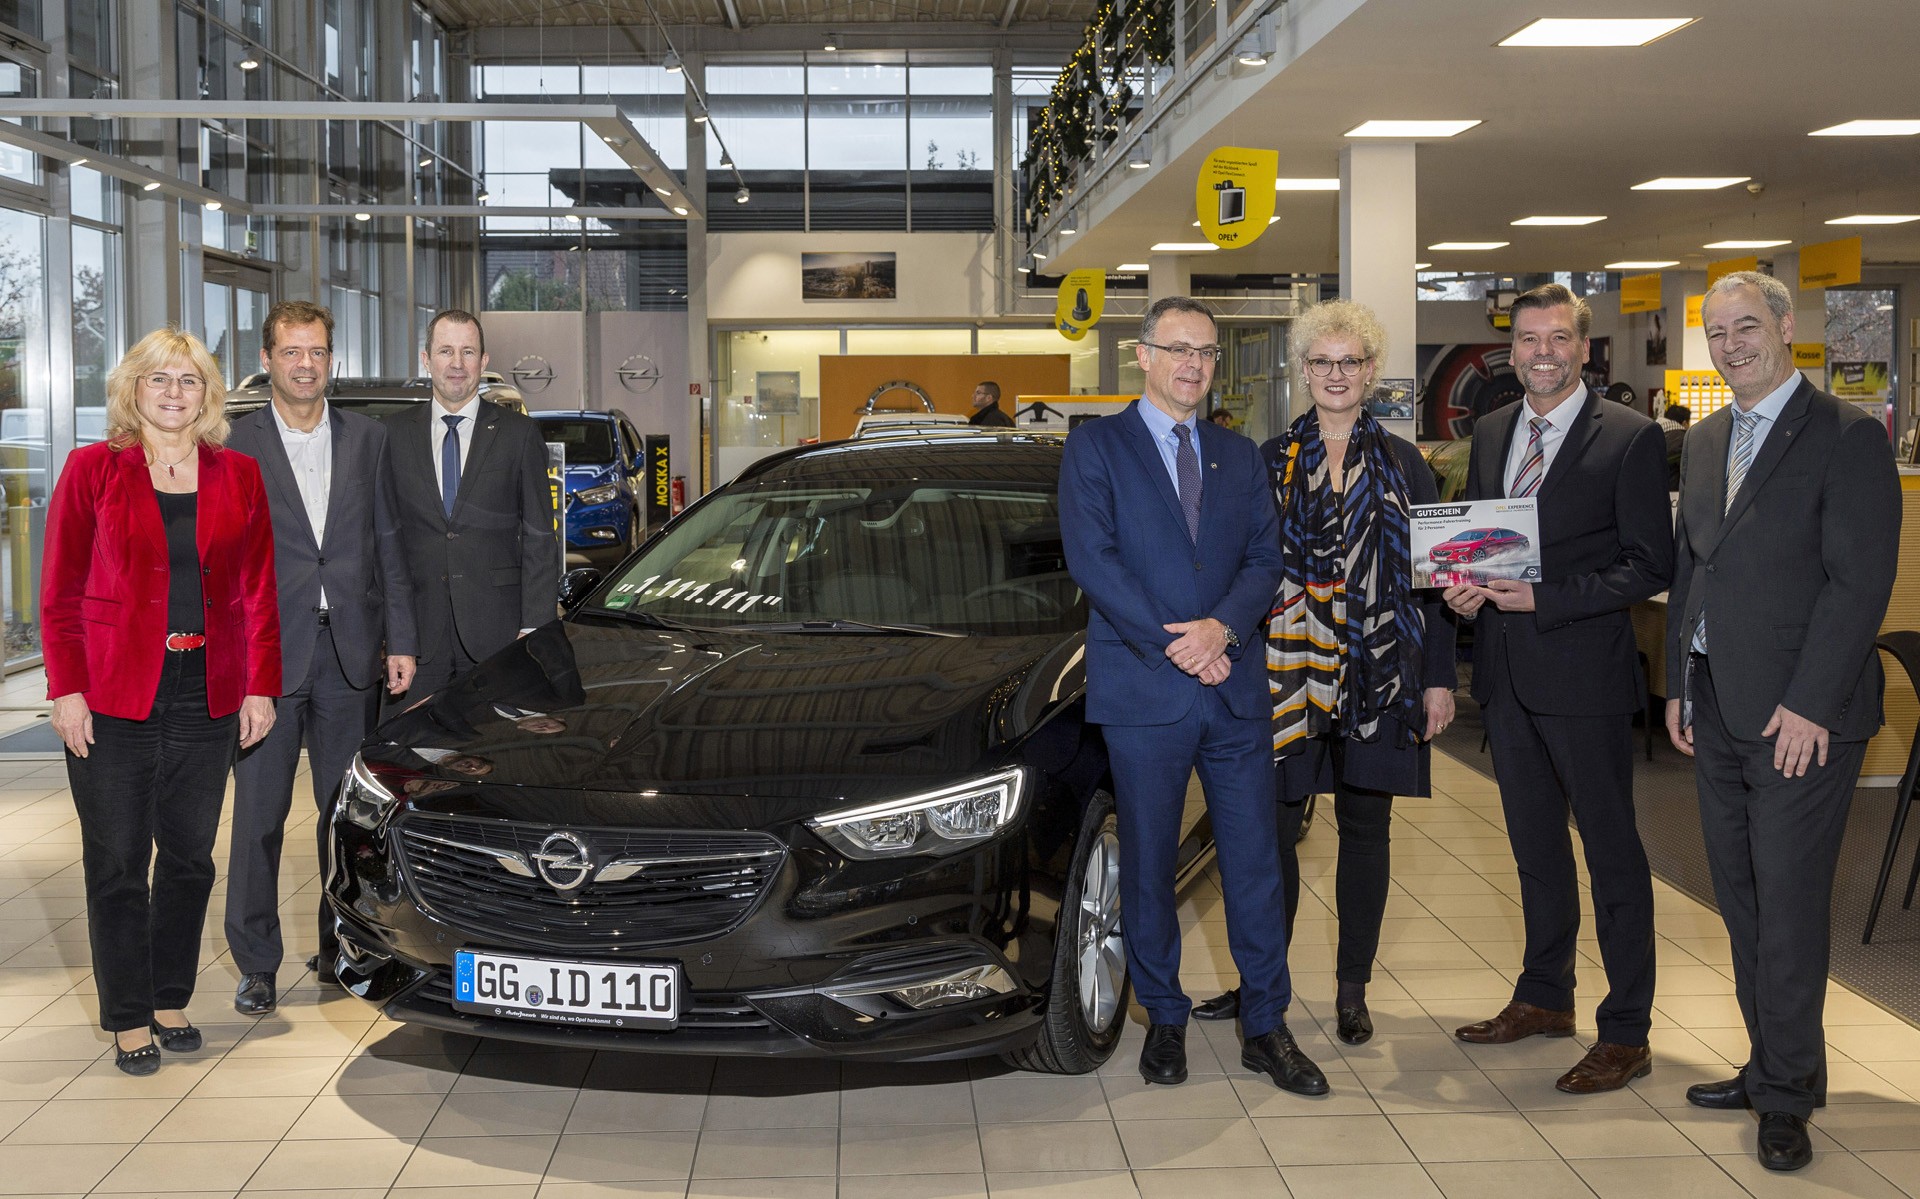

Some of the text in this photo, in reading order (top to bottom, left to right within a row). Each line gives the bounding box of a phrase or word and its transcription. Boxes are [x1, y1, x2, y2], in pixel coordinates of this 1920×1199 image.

[1796, 350, 1821, 359] Kasse
[657, 446, 668, 507] MOKKA X
[1417, 508, 1461, 517] GUTSCHEIN
[461, 981, 470, 993] D
[477, 960, 672, 1013] GG ID 110
